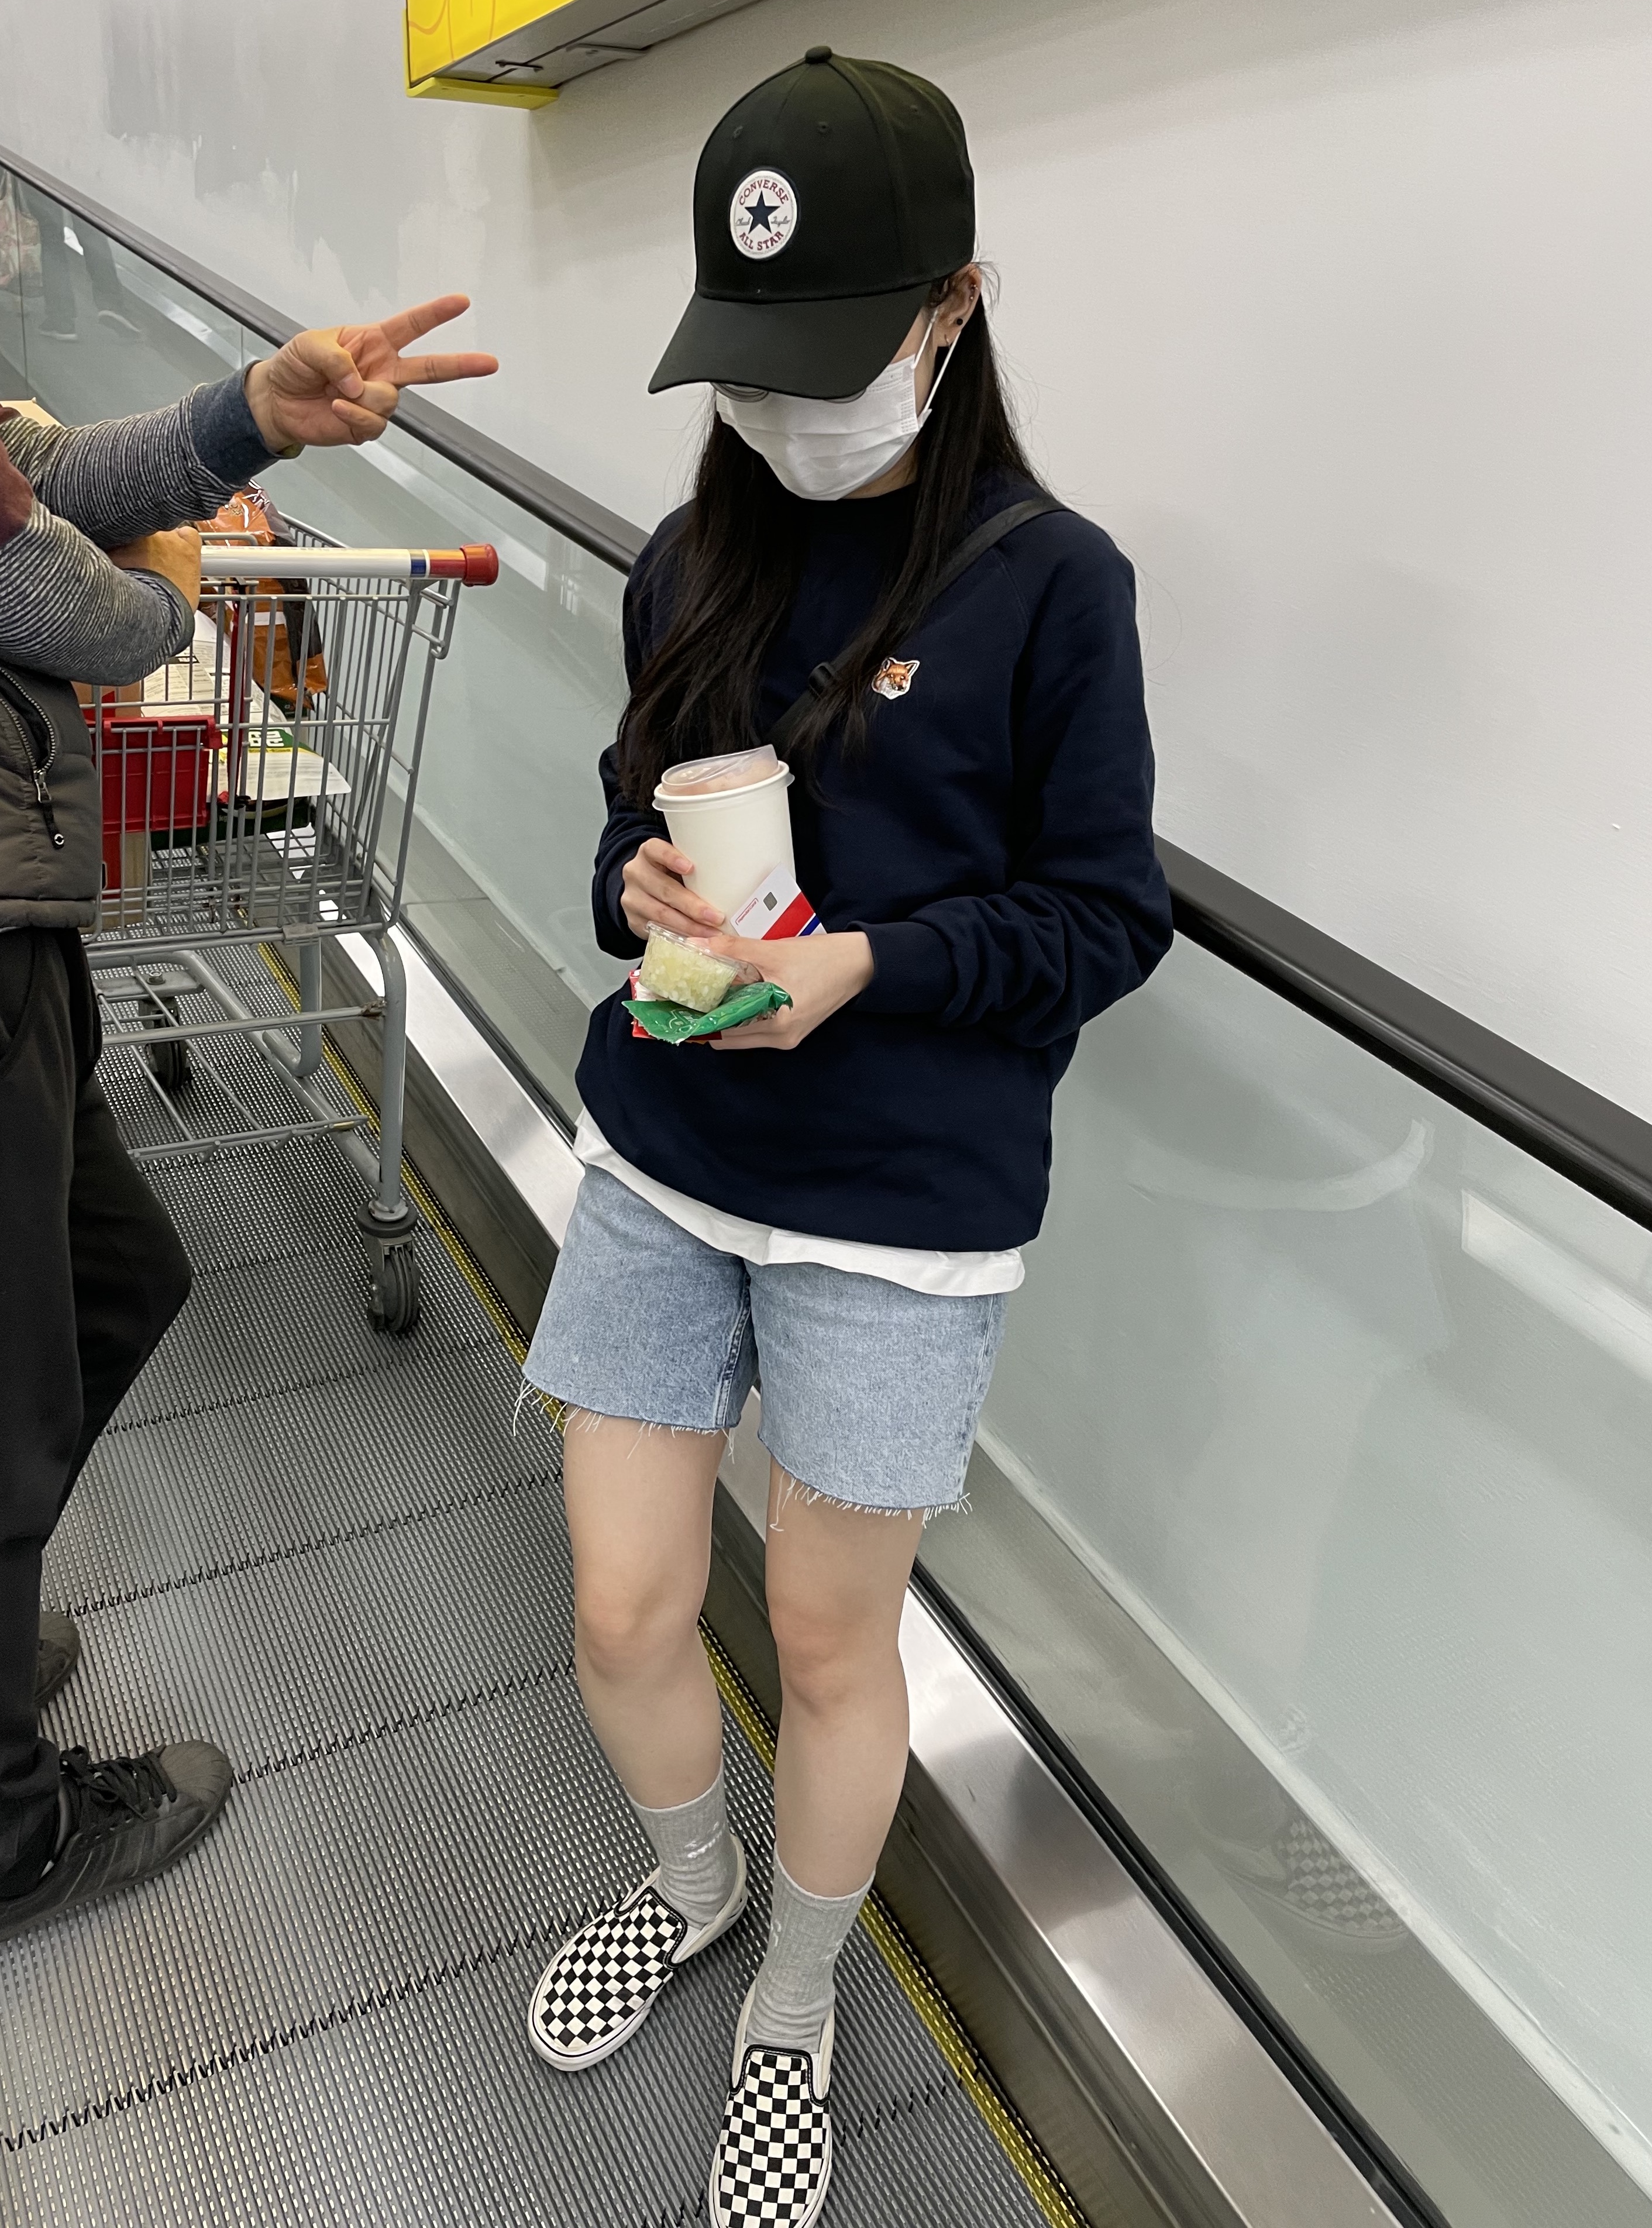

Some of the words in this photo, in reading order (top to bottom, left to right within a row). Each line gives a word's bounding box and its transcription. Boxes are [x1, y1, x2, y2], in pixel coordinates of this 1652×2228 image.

[739, 179, 789, 205] CONVERSE
[739, 232, 753, 250] ALL
[757, 231, 784, 251] STAR
